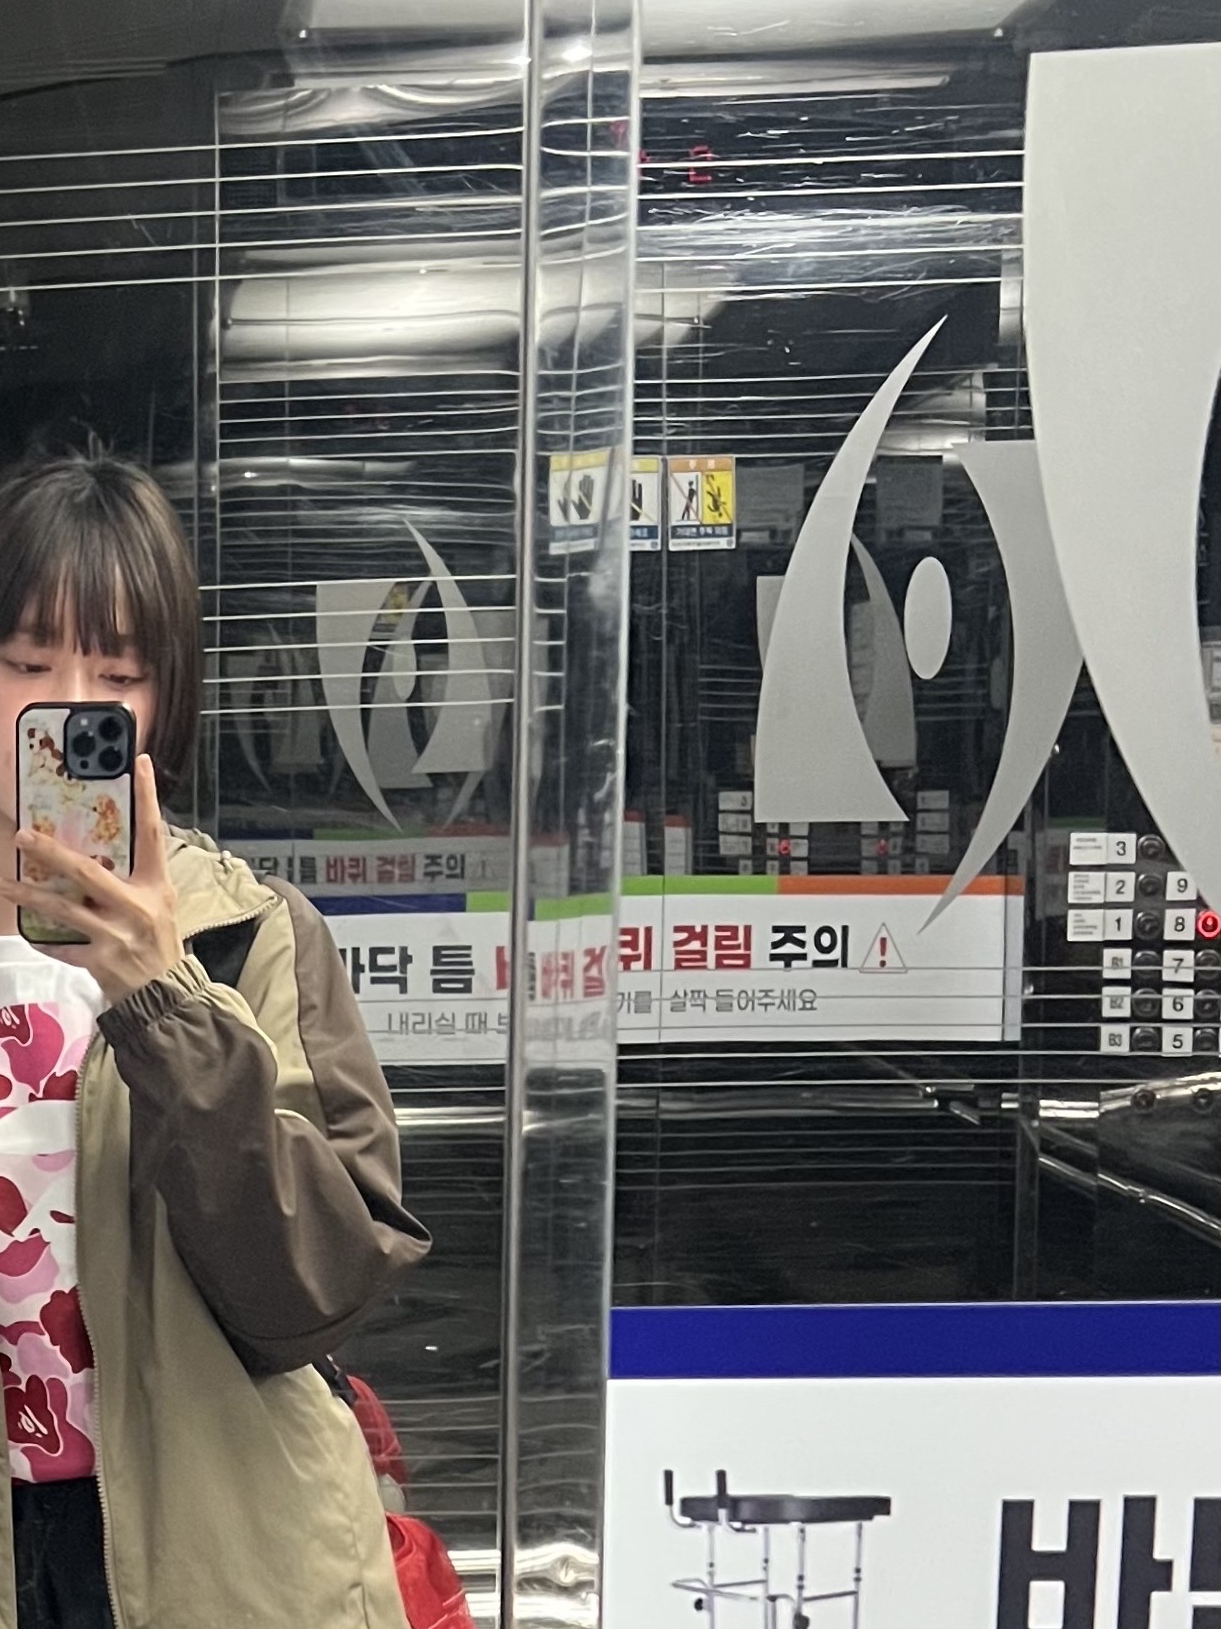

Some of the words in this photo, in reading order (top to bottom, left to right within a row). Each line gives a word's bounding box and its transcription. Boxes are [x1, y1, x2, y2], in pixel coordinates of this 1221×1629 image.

[1115, 840, 1126, 857] 3
[1115, 879, 1126, 895] 2
[1176, 878, 1188, 893] 9
[1115, 917, 1122, 932] 1
[1174, 916, 1186, 932] 8
[672, 924, 753, 971] 걸림
[769, 924, 850, 971] 주의
[1172, 957, 1184, 975] 7
[1172, 996, 1184, 1012] 6
[1172, 1033, 1184, 1049] 5
